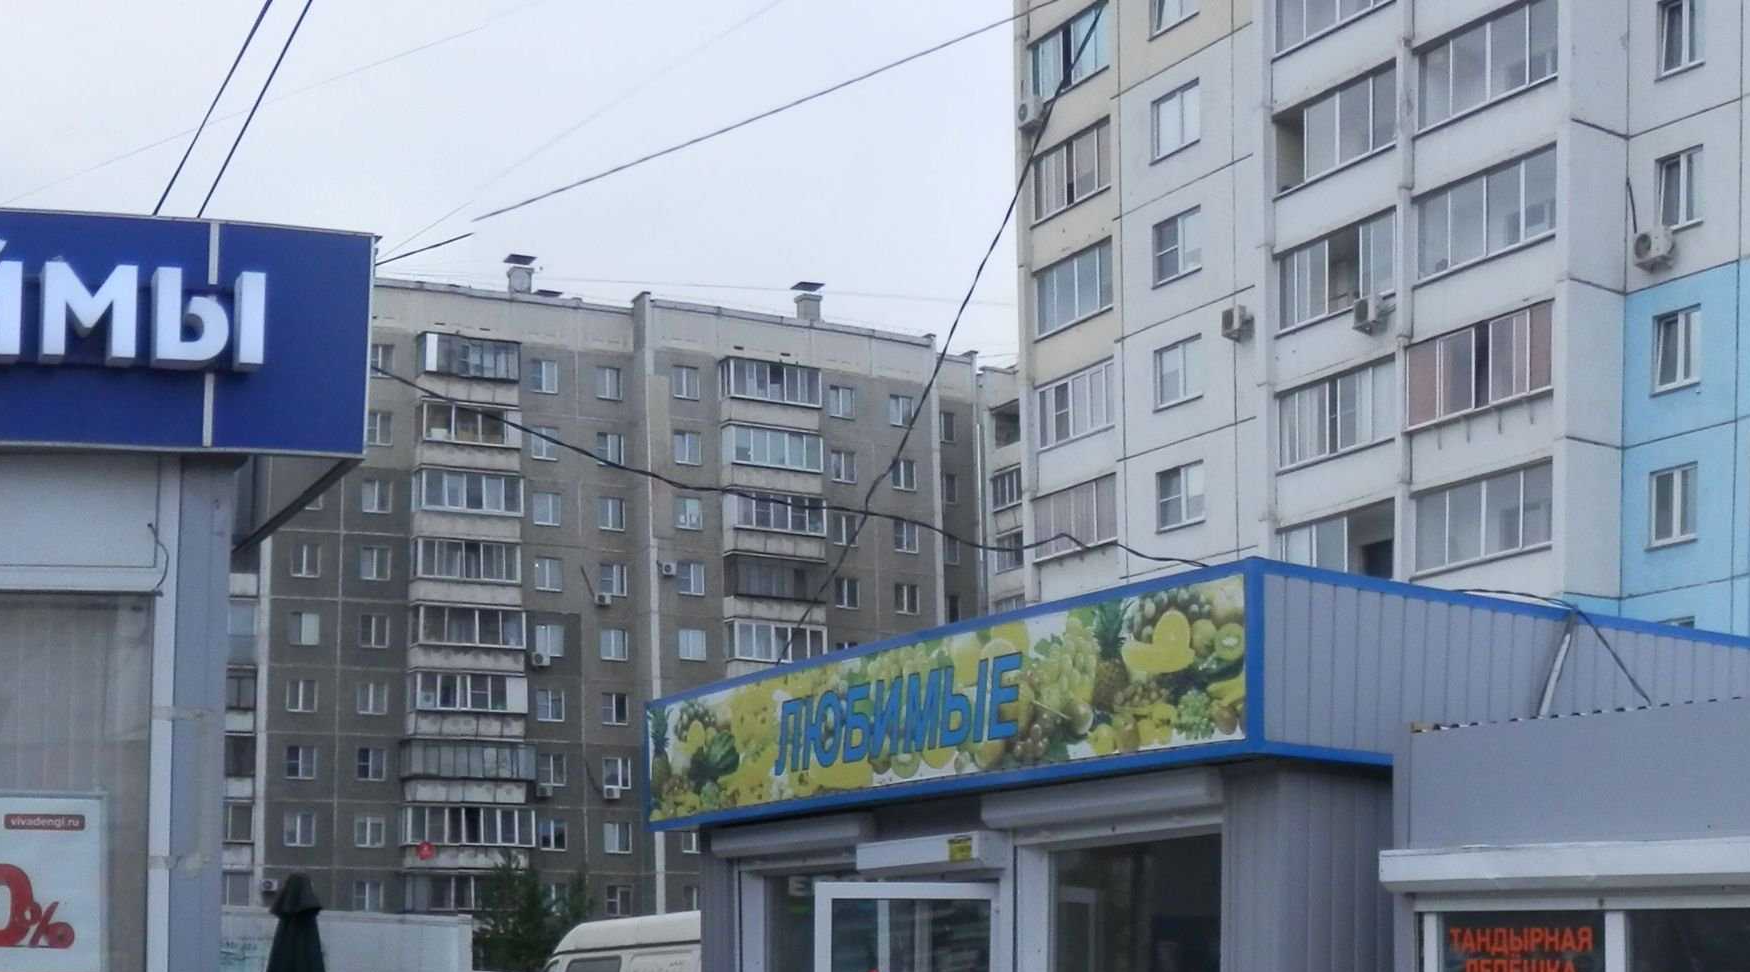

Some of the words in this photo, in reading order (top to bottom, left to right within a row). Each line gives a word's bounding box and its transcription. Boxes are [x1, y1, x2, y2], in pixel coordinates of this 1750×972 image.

[775, 651, 1024, 777] ЛЮБИМЫЕ
[9, 816, 80, 829] vivadengi.ru
[1450, 927, 1594, 956] ТАНДЫРНАЯ
